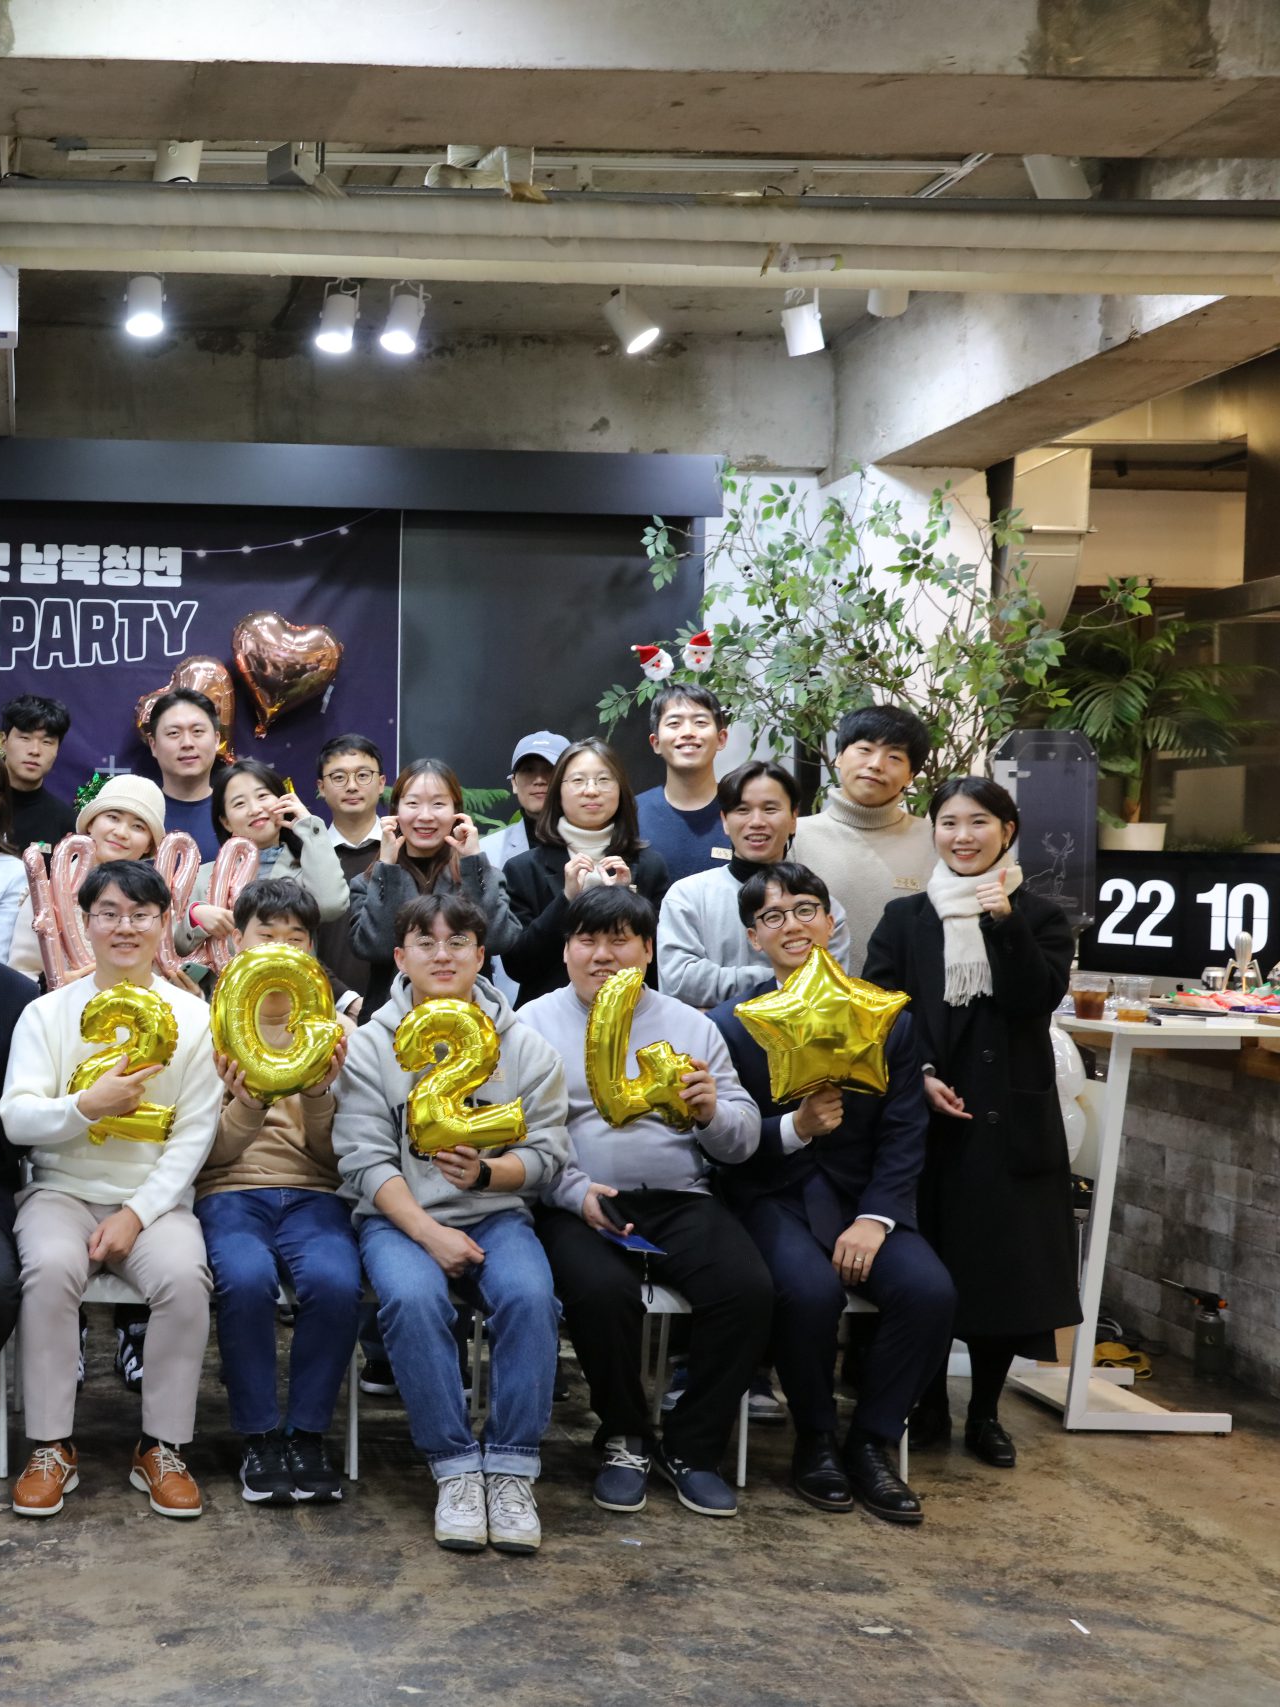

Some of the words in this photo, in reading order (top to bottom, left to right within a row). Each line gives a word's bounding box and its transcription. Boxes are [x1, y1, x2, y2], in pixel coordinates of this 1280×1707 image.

[20, 543, 182, 587] 남북청년
[1097, 878, 1176, 948] 22
[1195, 882, 1269, 954] 10
